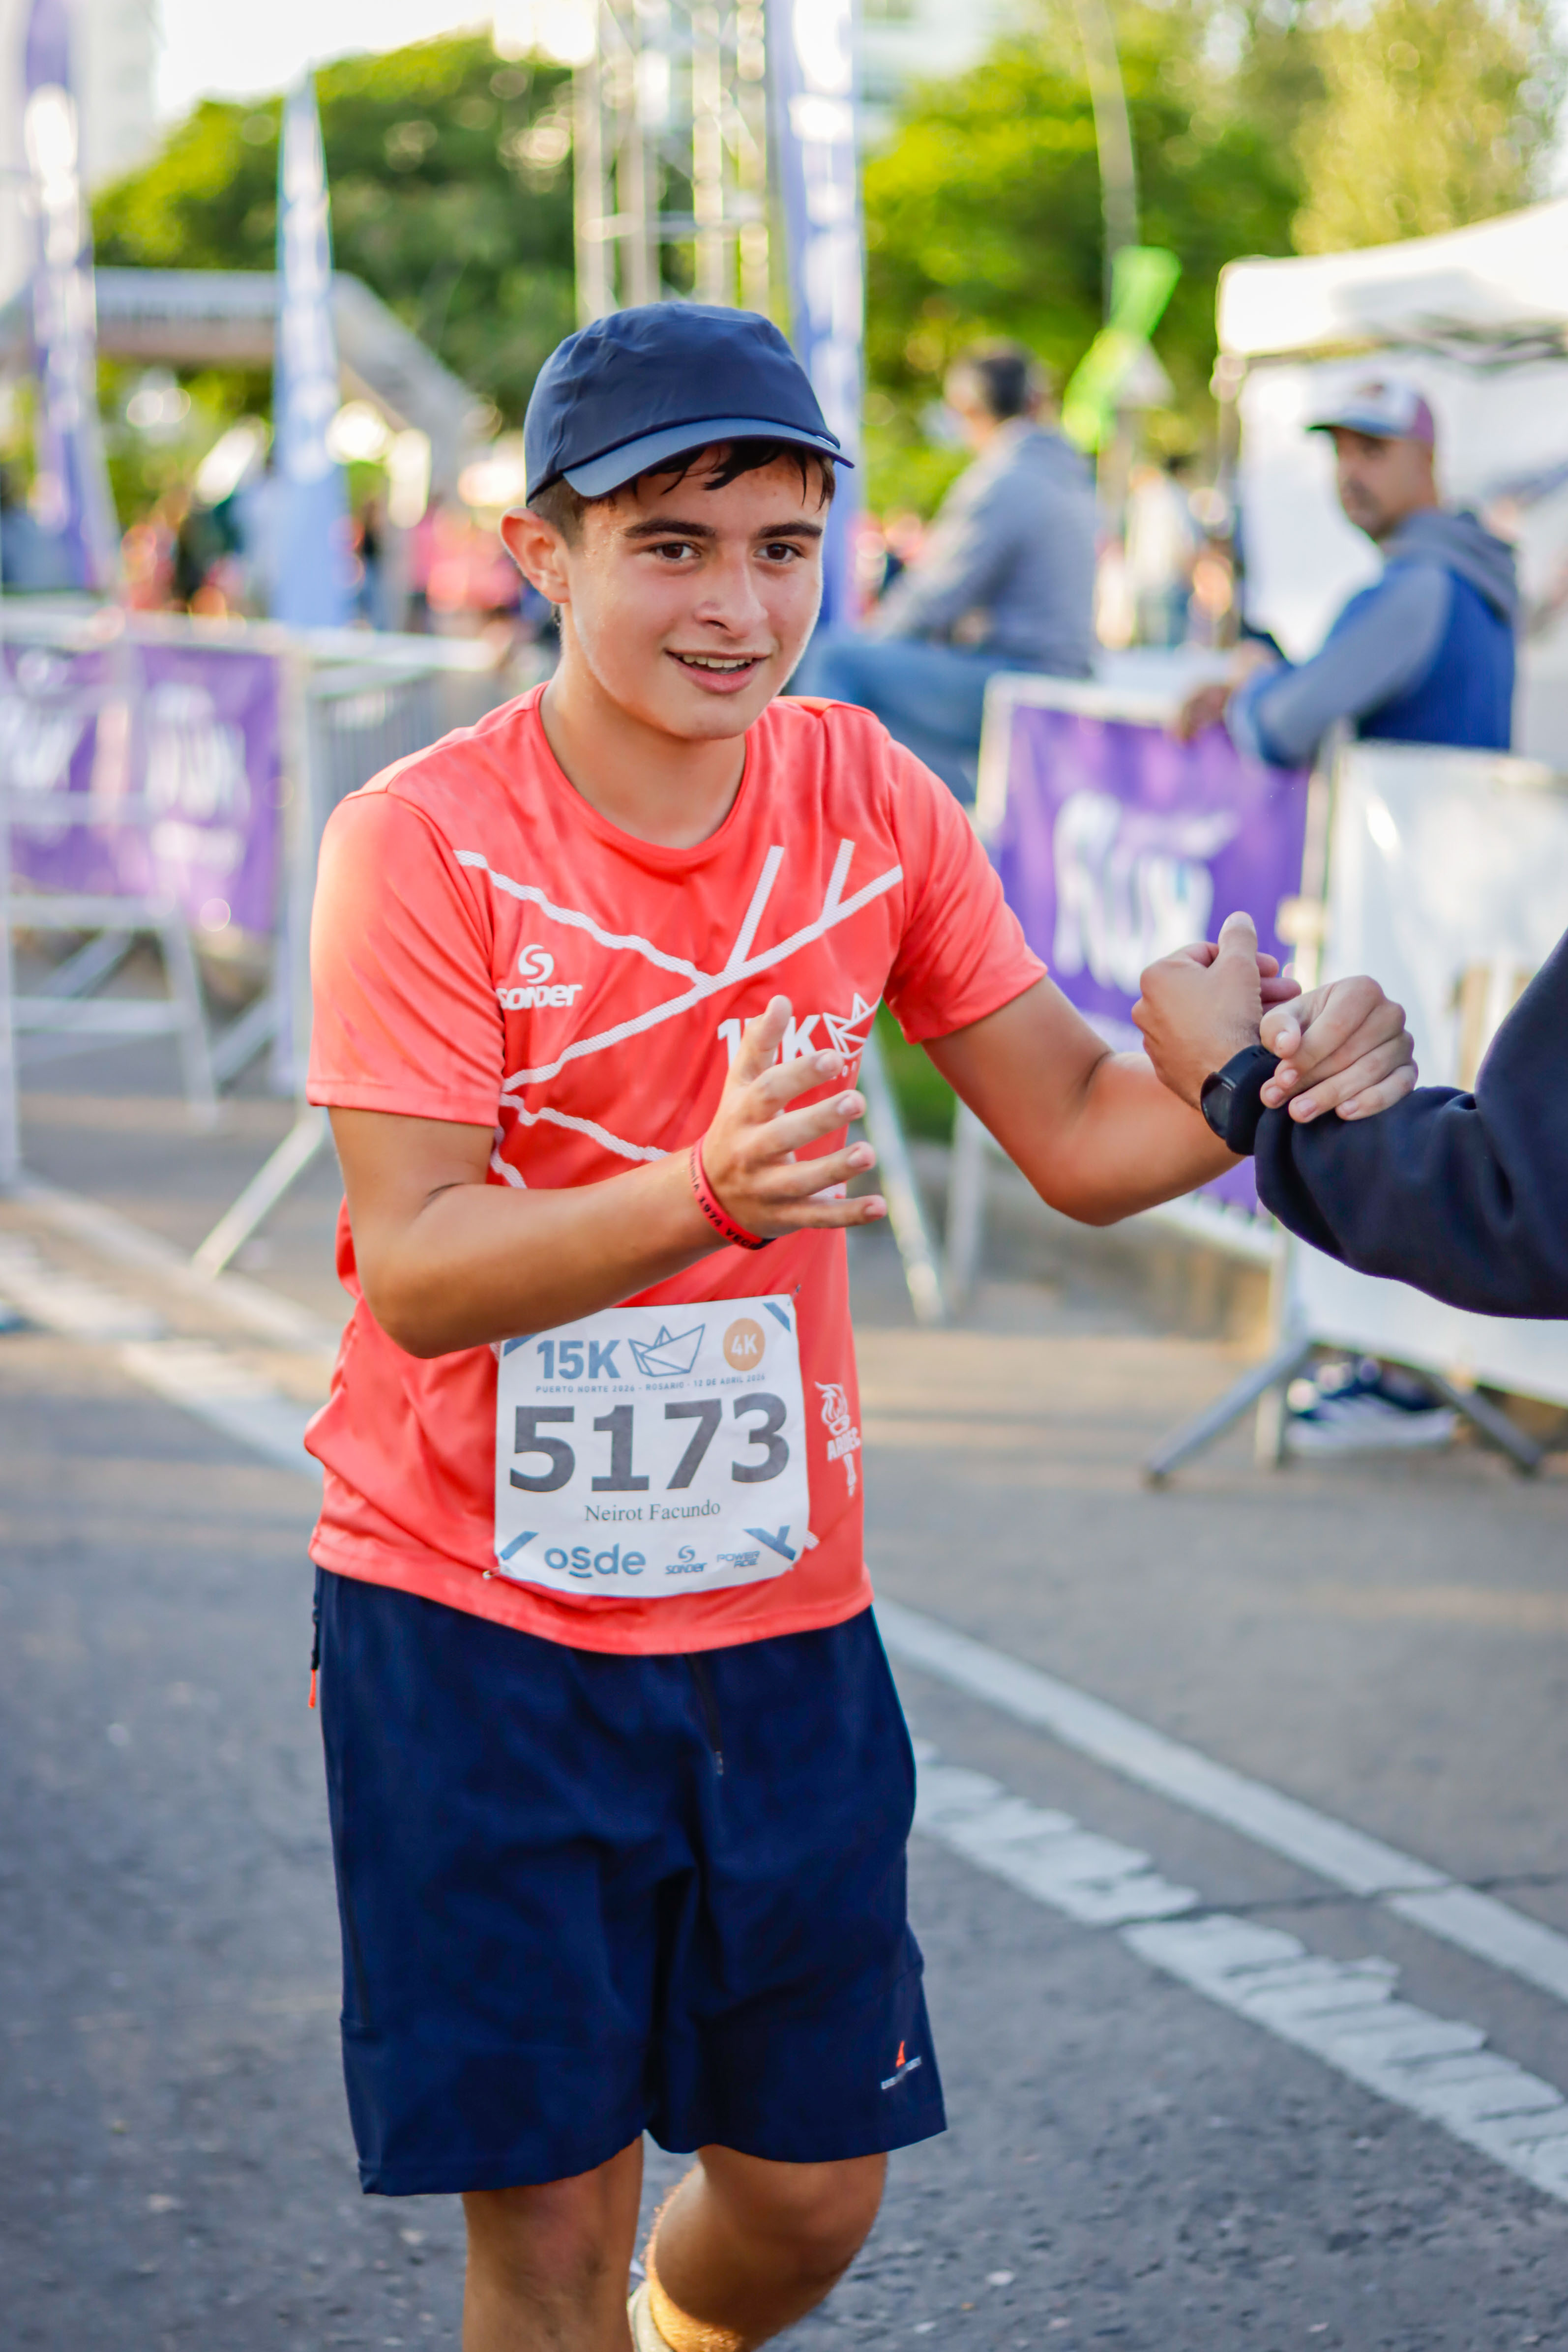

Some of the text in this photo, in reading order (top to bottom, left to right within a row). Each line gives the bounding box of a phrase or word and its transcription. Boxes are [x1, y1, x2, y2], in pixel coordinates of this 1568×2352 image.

[717, 1014, 821, 1067] 1K
[536, 1340, 621, 1380] 15K
[731, 1333, 758, 1355] 4K
[646, 1382, 684, 1391] ROSARIO
[720, 1376, 743, 1384] ABRIL
[747, 1373, 766, 1382] 2026
[509, 1392, 790, 1493] 5173
[585, 1499, 721, 1522] Neirot Facundo
[544, 1543, 647, 1575] osde
